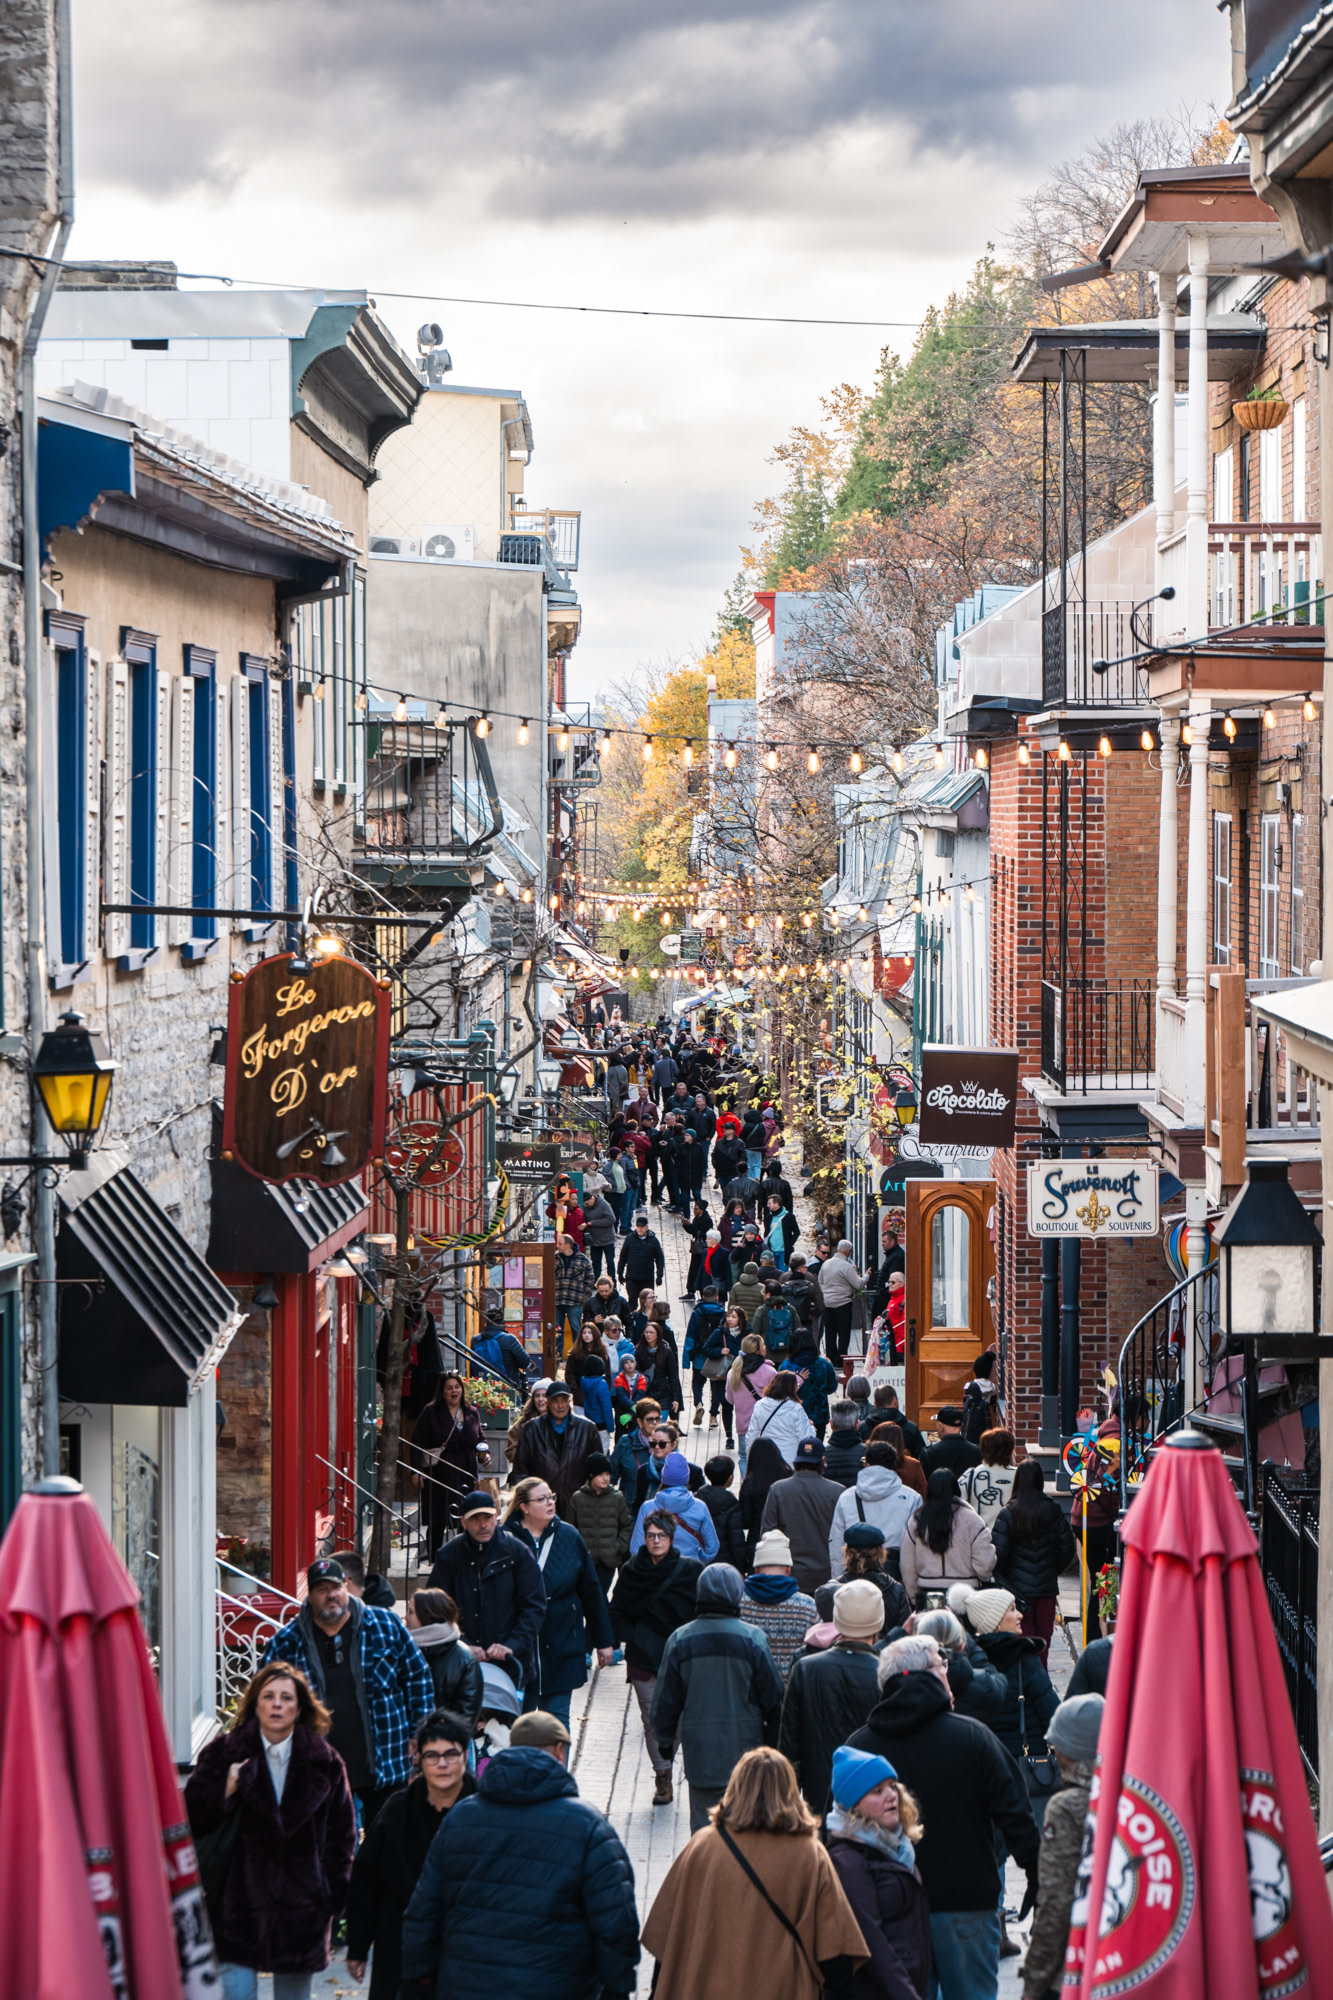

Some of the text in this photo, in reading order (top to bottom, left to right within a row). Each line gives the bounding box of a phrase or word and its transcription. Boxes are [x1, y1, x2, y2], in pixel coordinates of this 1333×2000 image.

[276, 980, 316, 1017] Le
[241, 1001, 376, 1079] Forgeron
[926, 1084, 1010, 1115] Chocolato
[504, 1160, 551, 1169] MARTINO
[1086, 1165, 1099, 1175] LE
[1036, 1221, 1152, 1232] BOUTIQUE SOUVENIRS
